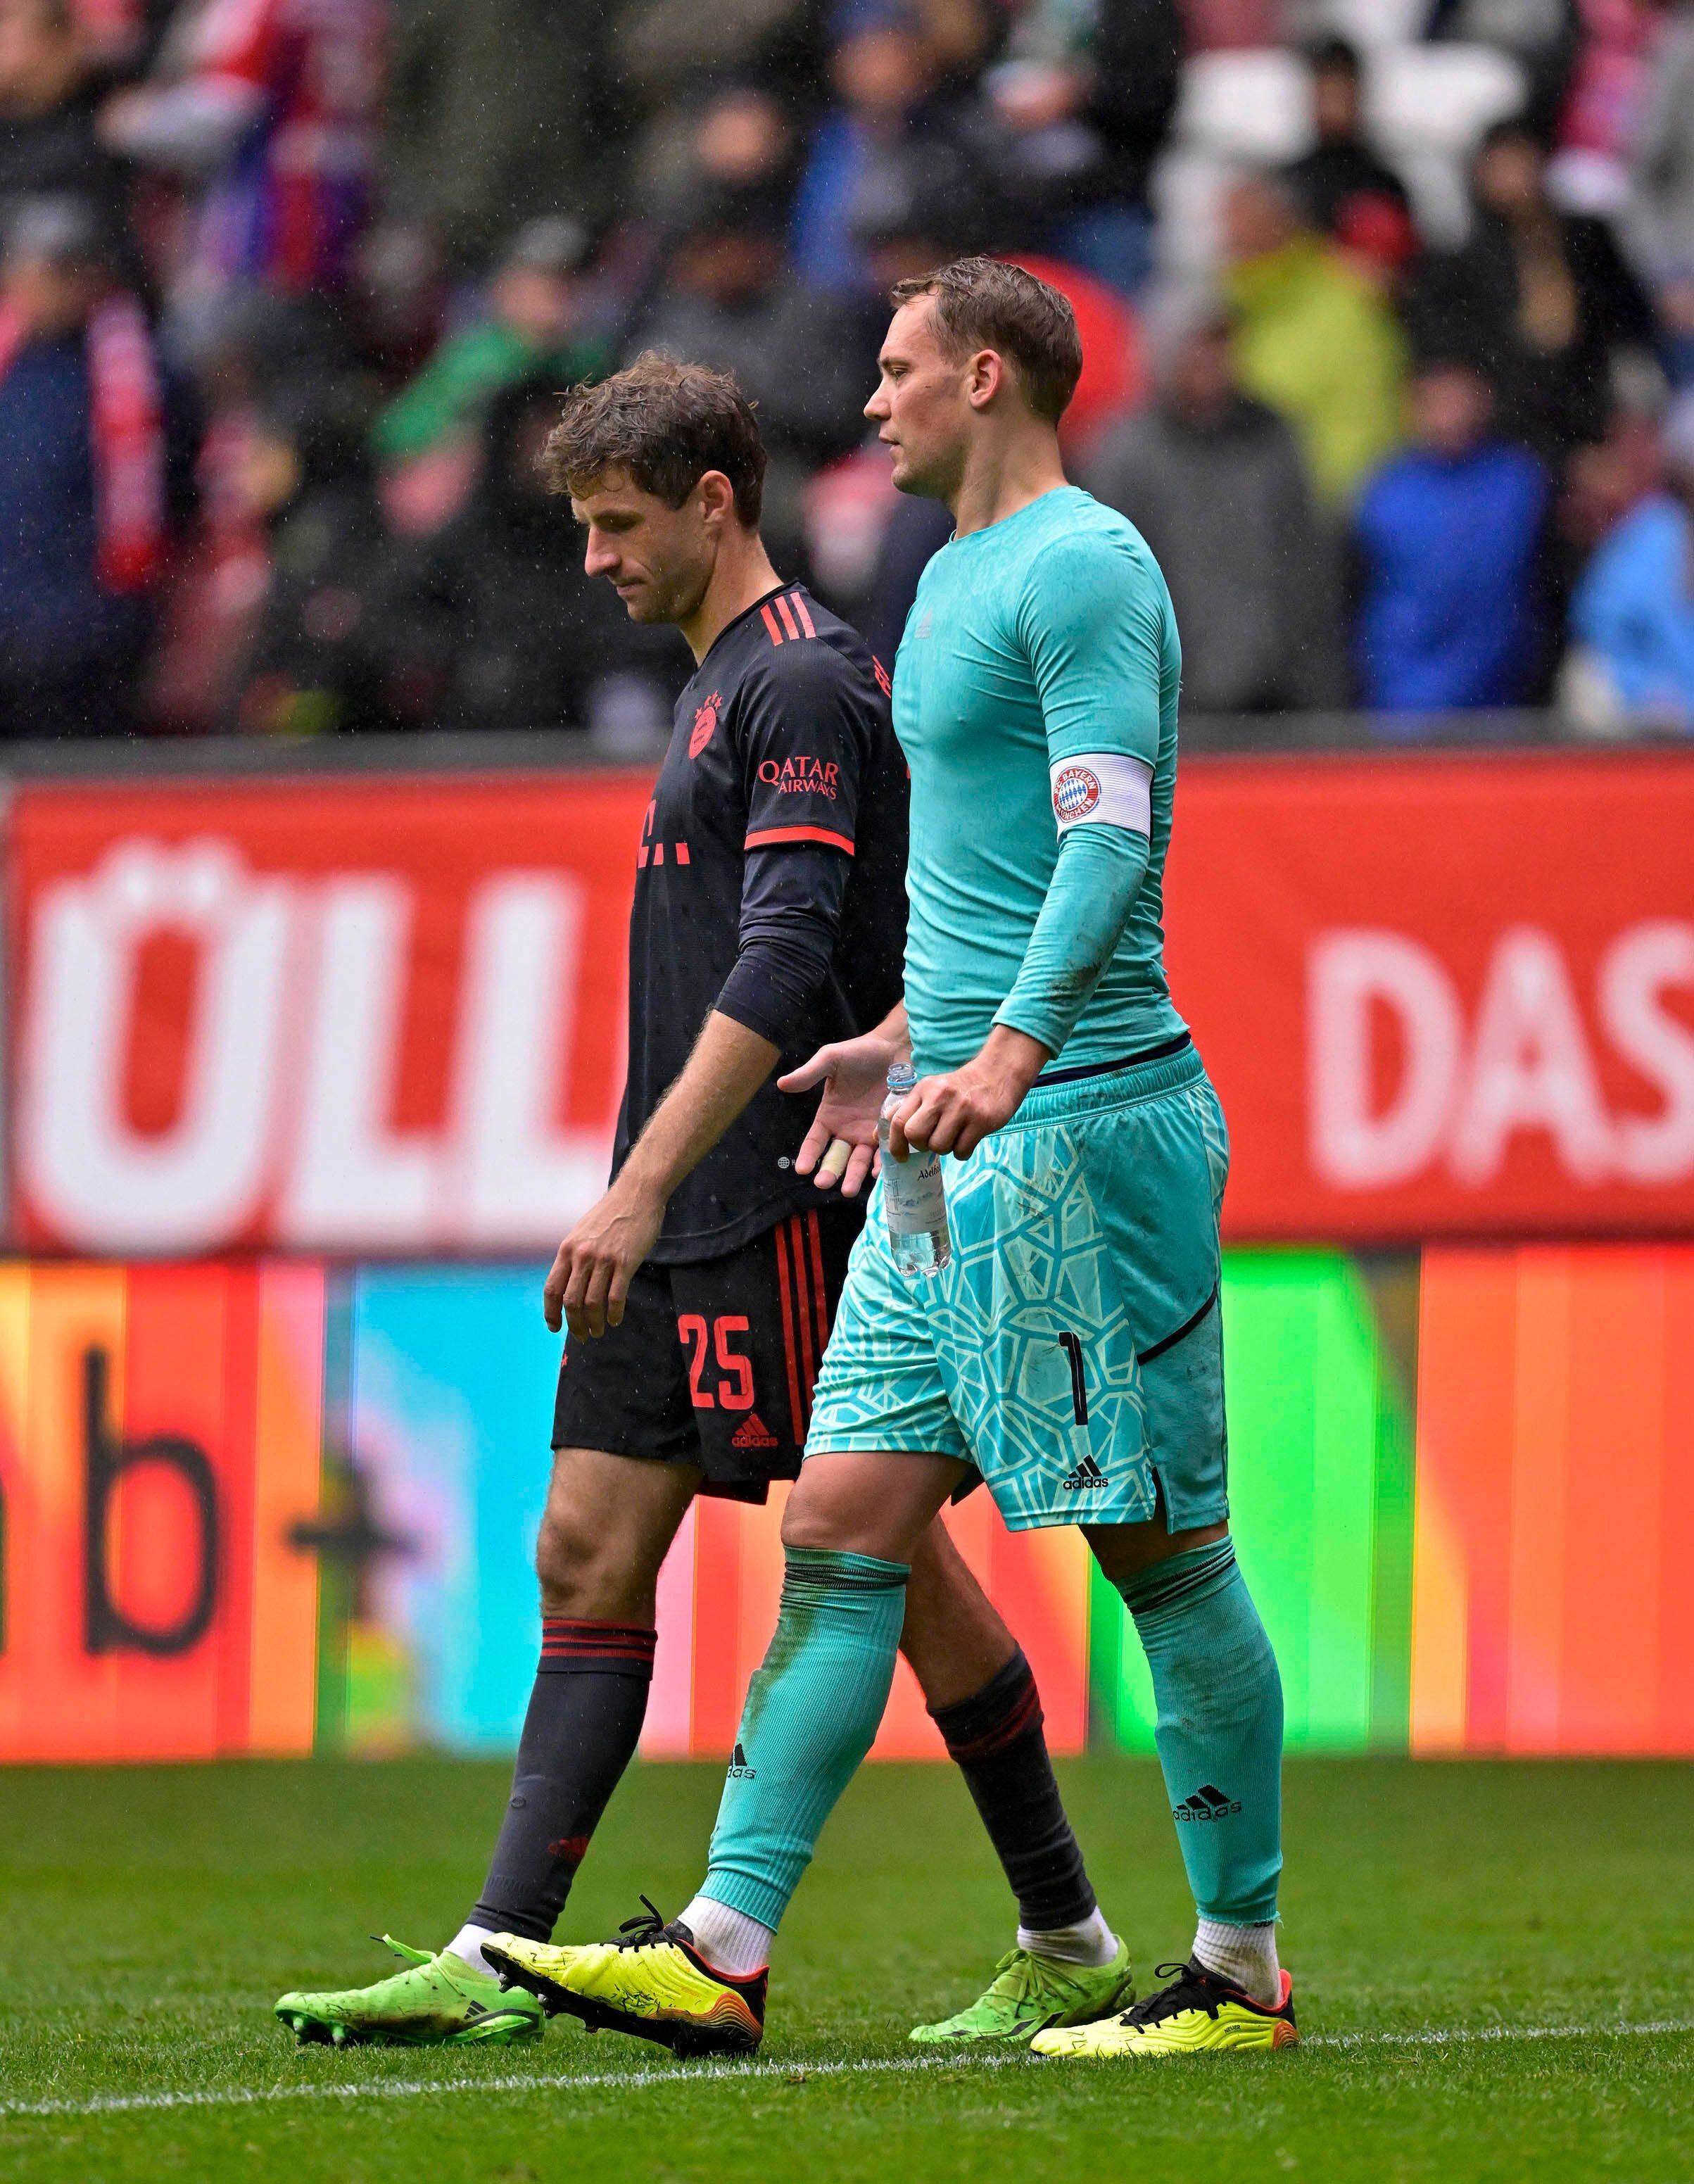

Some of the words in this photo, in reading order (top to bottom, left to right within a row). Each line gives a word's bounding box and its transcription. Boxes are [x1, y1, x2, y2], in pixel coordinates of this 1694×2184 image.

[758, 756, 839, 786] QATAR
[1062, 770, 1096, 790] BAYERN
[778, 779, 837, 800] AIRWAYS
[1306, 922, 1694, 1189] DAS
[678, 1314, 754, 1410] 25
[1058, 1331, 1088, 1425] 1
[731, 1436, 778, 1448] adidas
[1063, 1477, 1108, 1490] adidas
[1172, 1801, 1241, 1822] adidas
